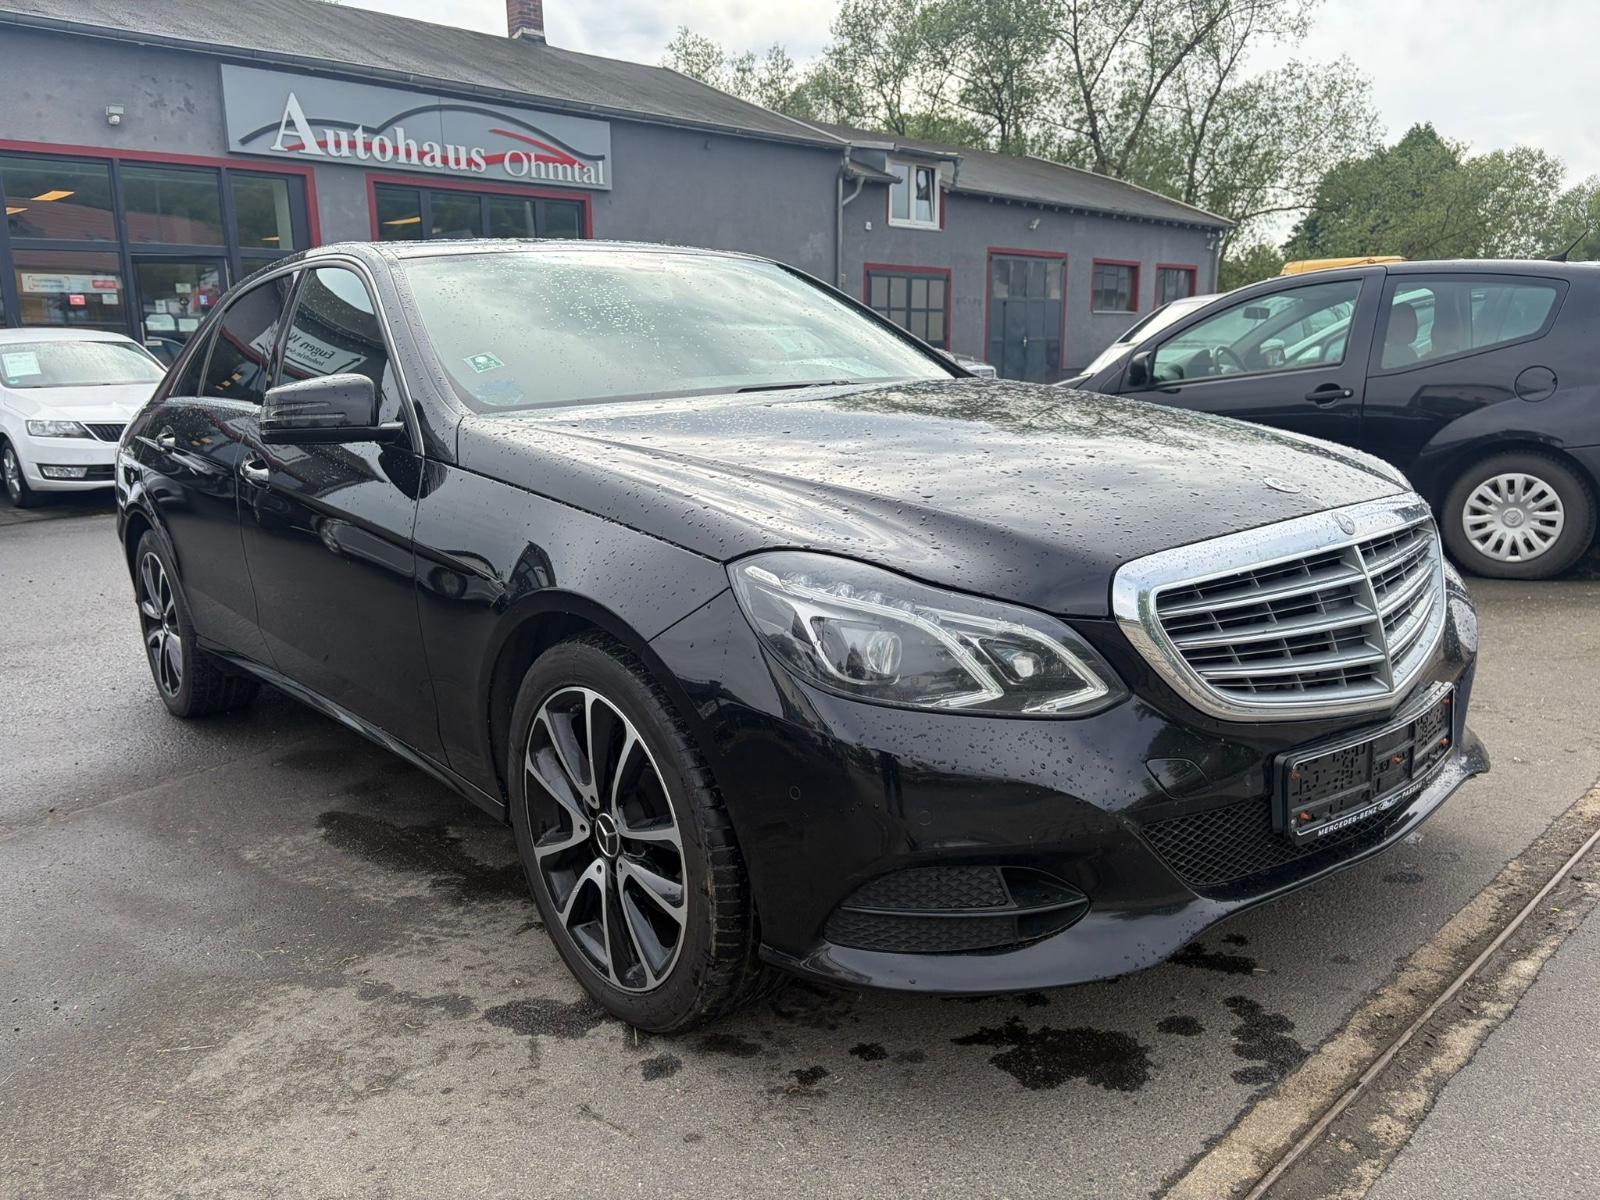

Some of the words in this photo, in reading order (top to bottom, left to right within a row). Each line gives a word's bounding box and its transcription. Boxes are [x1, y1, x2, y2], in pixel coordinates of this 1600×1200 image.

[270, 91, 487, 173] Autohaus
[503, 149, 605, 186] Ohmtal
[1317, 806, 1378, 837] MERCEDES-BENZ
